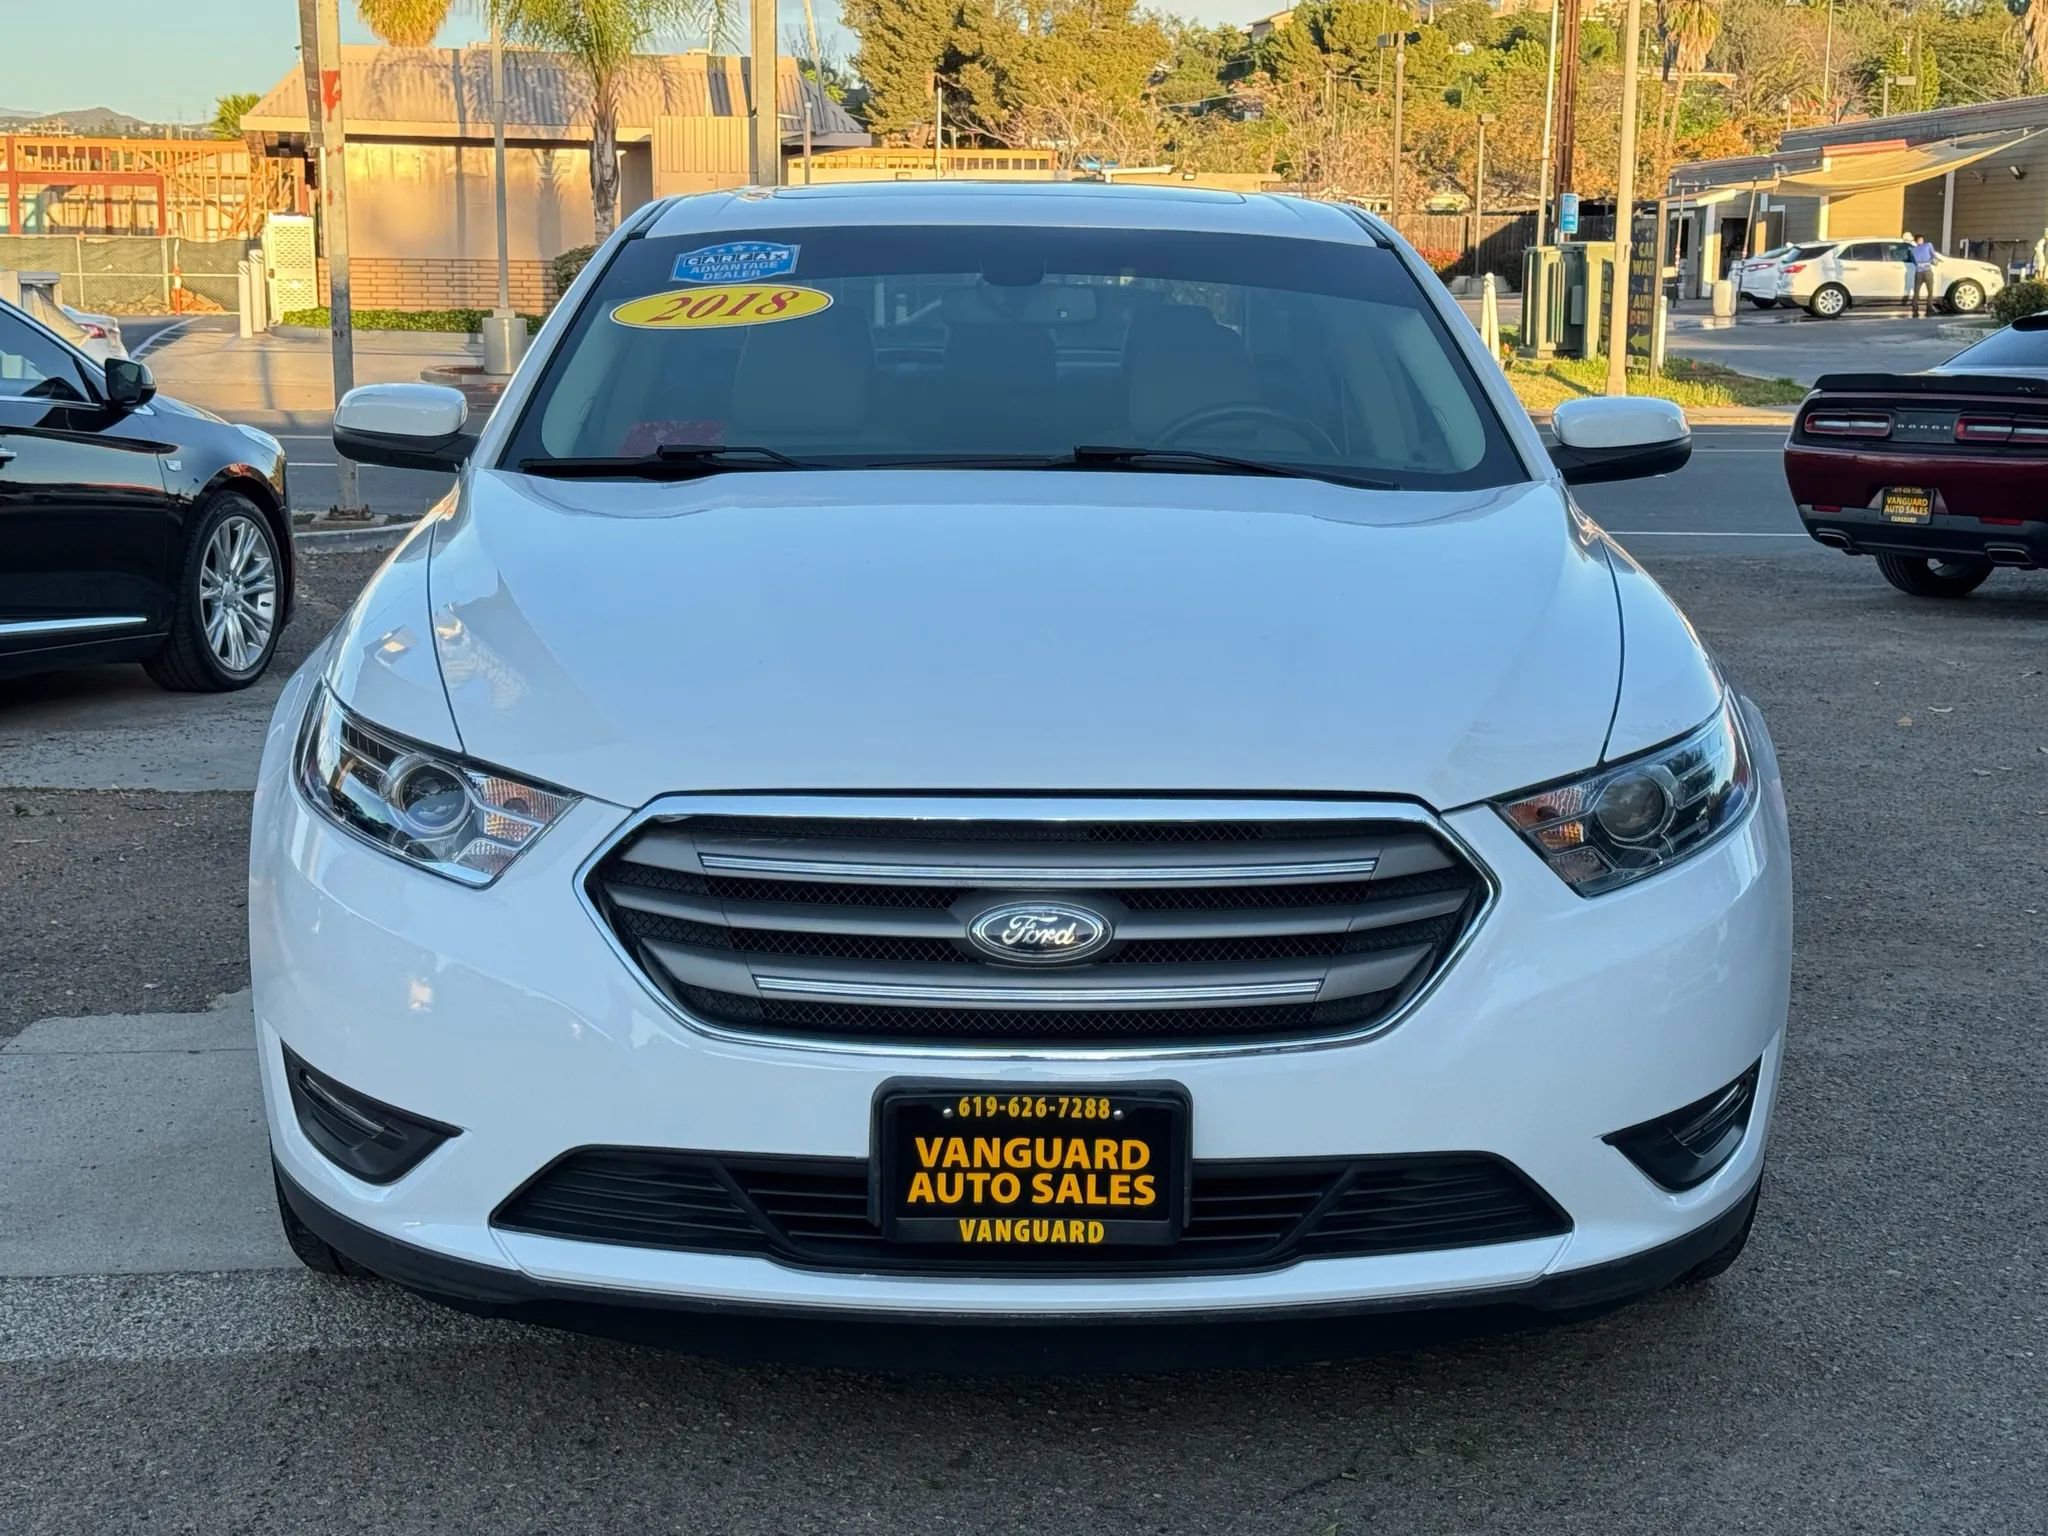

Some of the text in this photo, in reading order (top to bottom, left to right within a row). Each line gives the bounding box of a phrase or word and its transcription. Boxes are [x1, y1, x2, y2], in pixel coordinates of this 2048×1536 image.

[686, 251, 789, 266] CARFAX
[689, 260, 778, 274] ADVANTAGE
[703, 269, 761, 281] DEALER
[644, 290, 800, 323] 2018
[1884, 504, 1929, 516] AUTO SALES
[1886, 496, 1929, 507] VANGUARD
[1001, 915, 1077, 945] Ford
[958, 1096, 1111, 1119] 619-626-7288
[915, 1136, 1151, 1170] VANGUARD
[906, 1171, 1157, 1206] AUTO SALES
[958, 1218, 1106, 1244] VANGUARD
